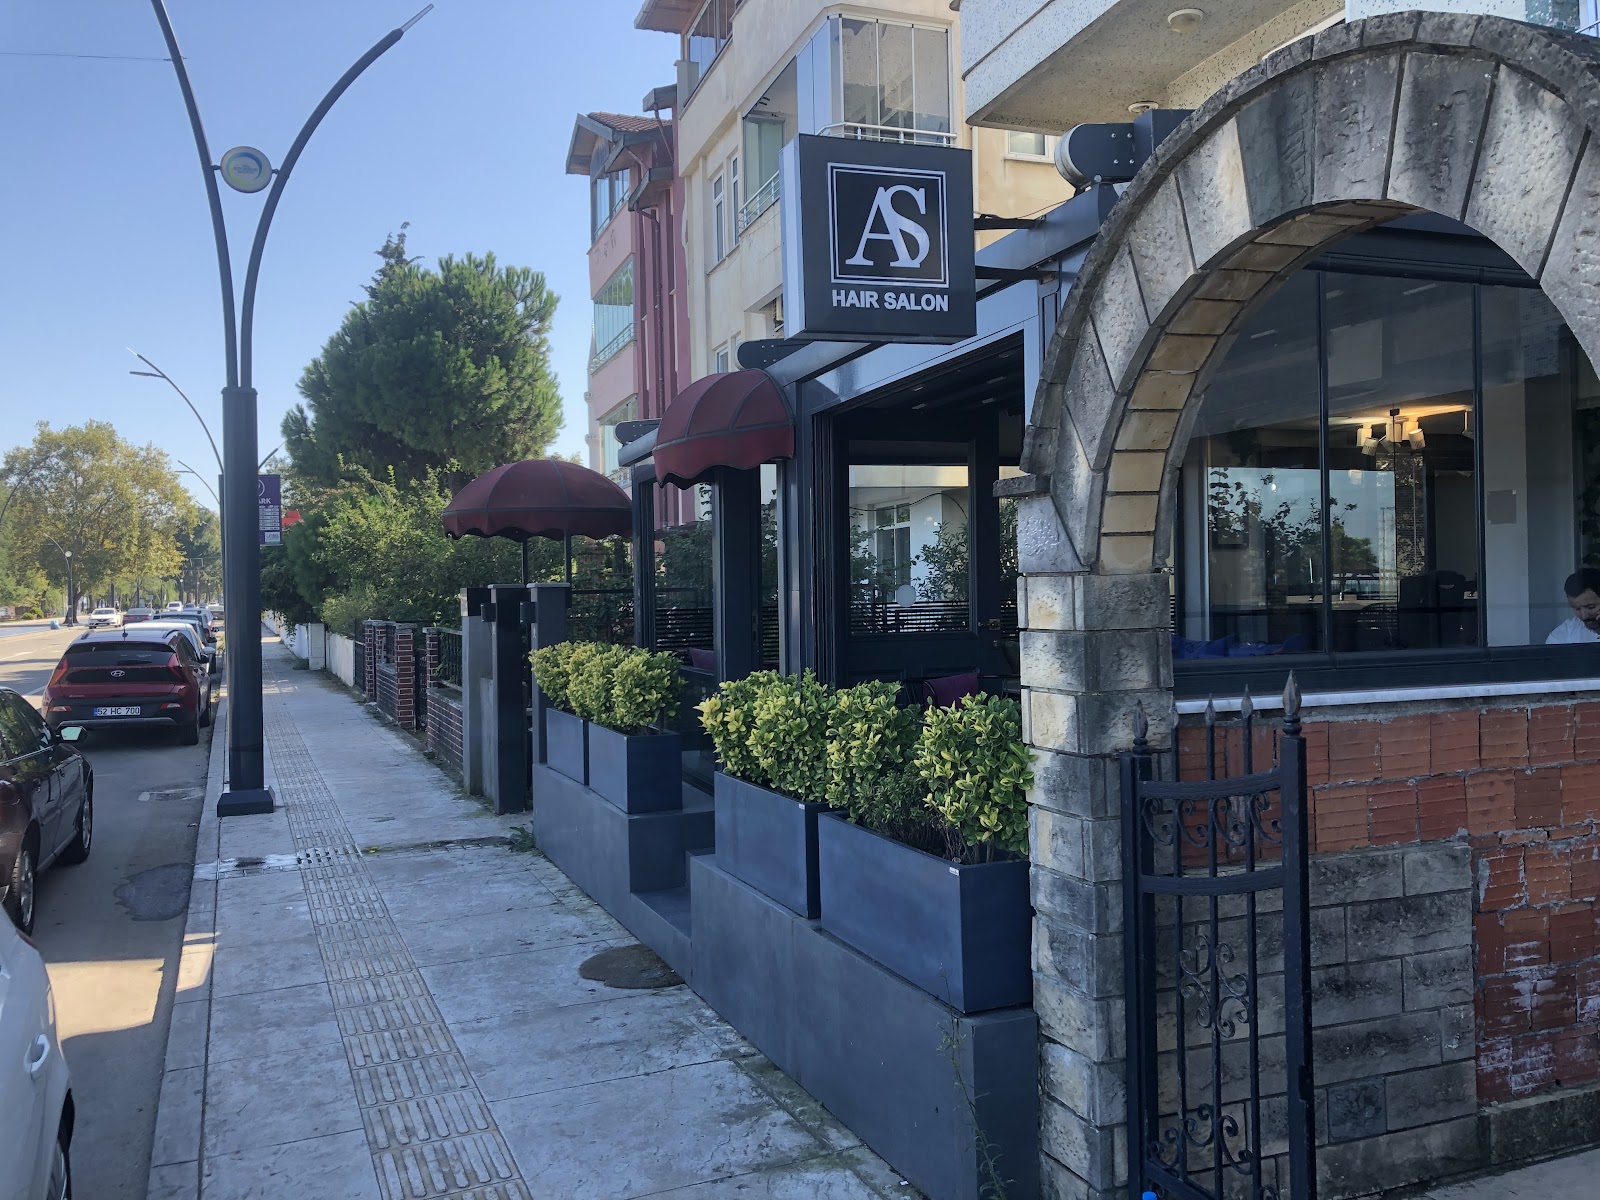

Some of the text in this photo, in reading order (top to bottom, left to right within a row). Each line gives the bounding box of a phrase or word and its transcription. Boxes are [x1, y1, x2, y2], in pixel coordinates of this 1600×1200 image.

[845, 184, 930, 268] AS
[832, 289, 949, 312] HAIR SALON
[97, 706, 140, 716] 52 HC 700
